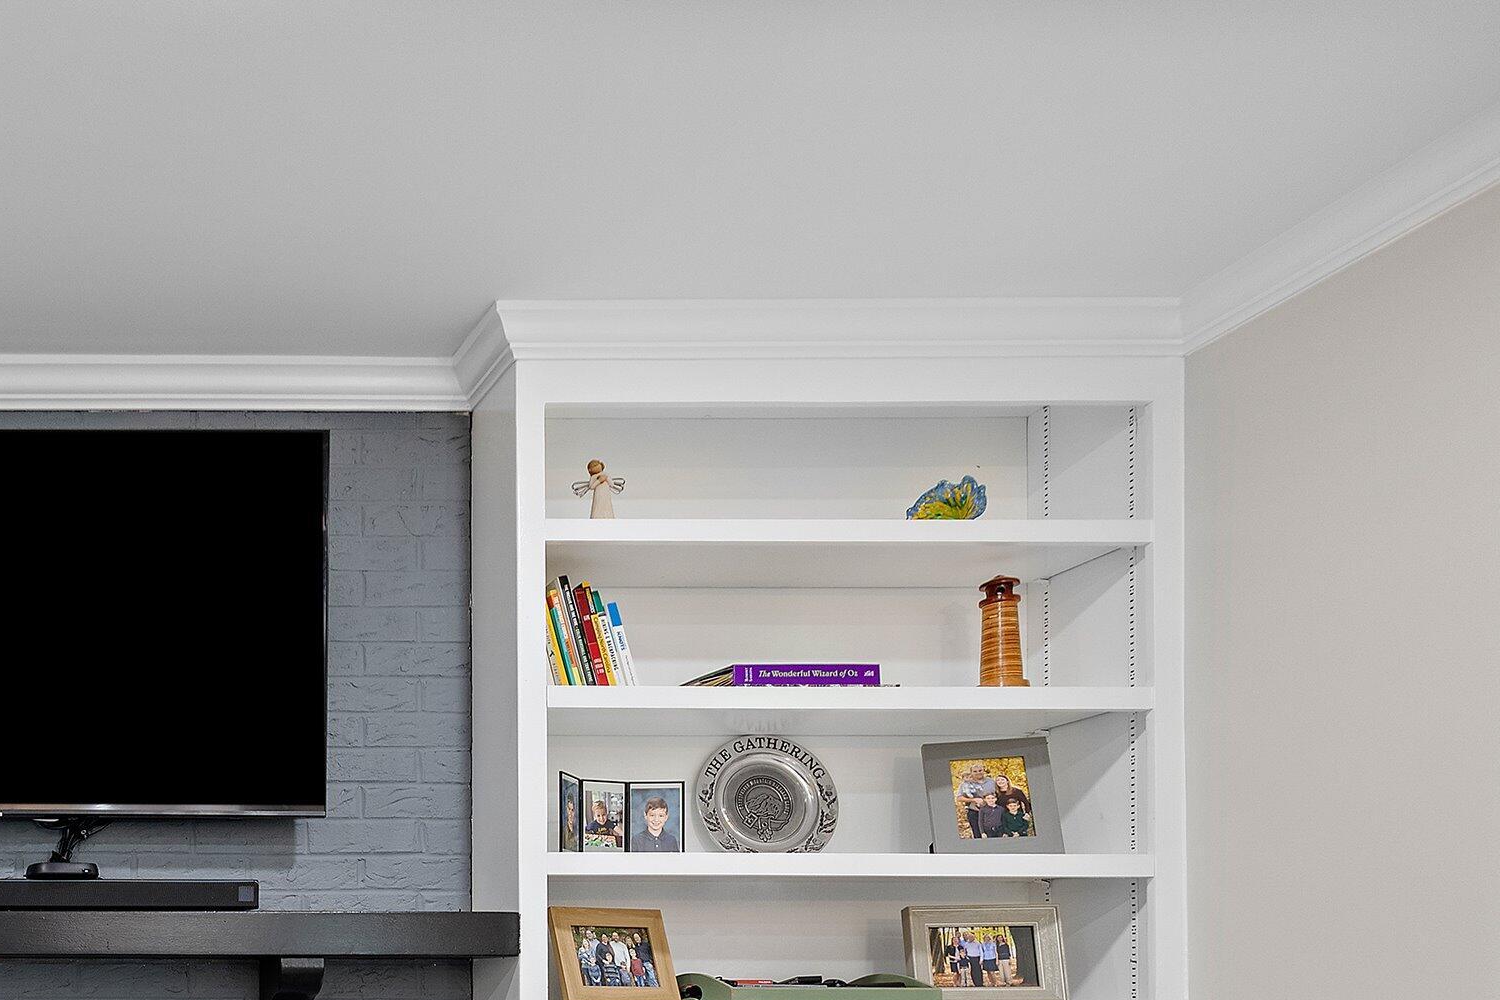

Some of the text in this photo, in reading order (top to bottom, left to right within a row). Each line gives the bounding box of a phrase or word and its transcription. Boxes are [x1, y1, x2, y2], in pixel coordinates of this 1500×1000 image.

[606, 641, 619, 671] BACKPACKING
[839, 670, 846, 678] of
[705, 737, 826, 780] THE GATHERING
